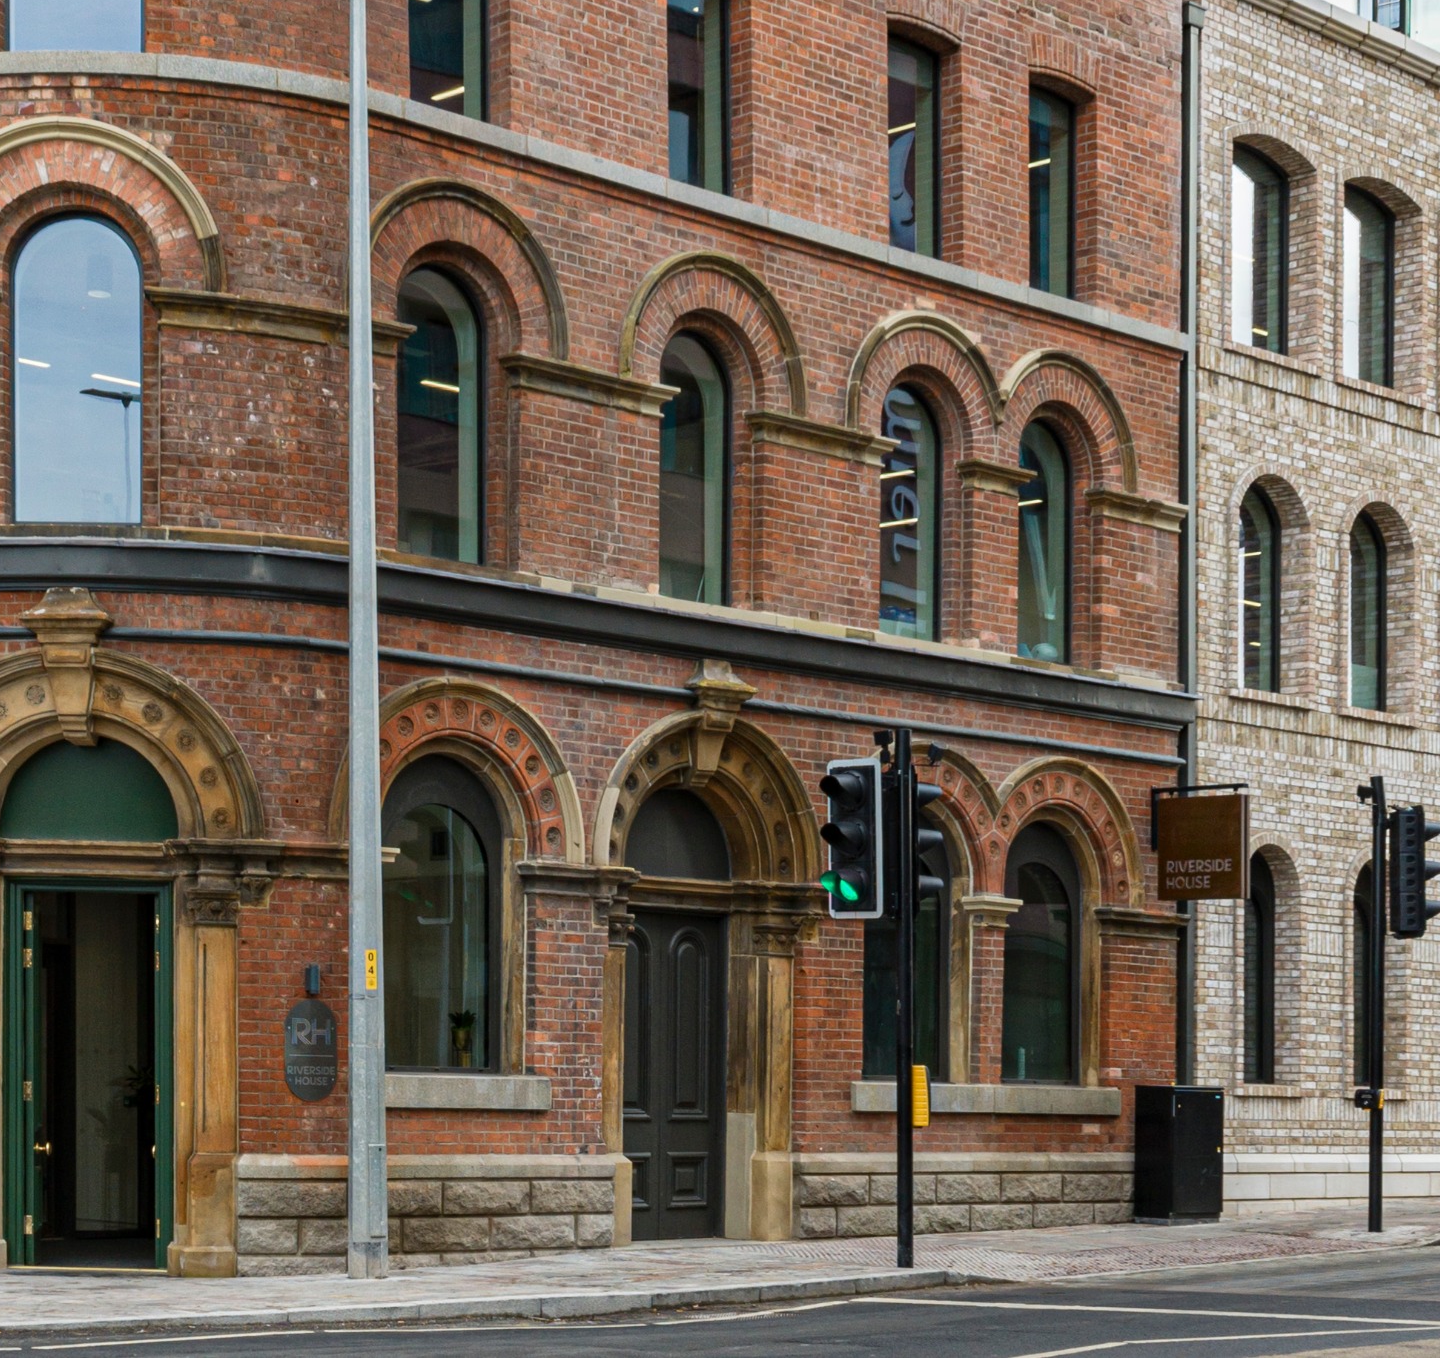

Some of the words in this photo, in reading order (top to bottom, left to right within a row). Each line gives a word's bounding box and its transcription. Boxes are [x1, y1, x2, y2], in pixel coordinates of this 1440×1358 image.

[1166, 858, 1232, 873] RIVERSIDE
[1166, 875, 1211, 889] HOUSE
[291, 1017, 332, 1046] RH
[287, 1065, 336, 1075] RIVERSIDE
[294, 1076, 329, 1086] HOUSE
